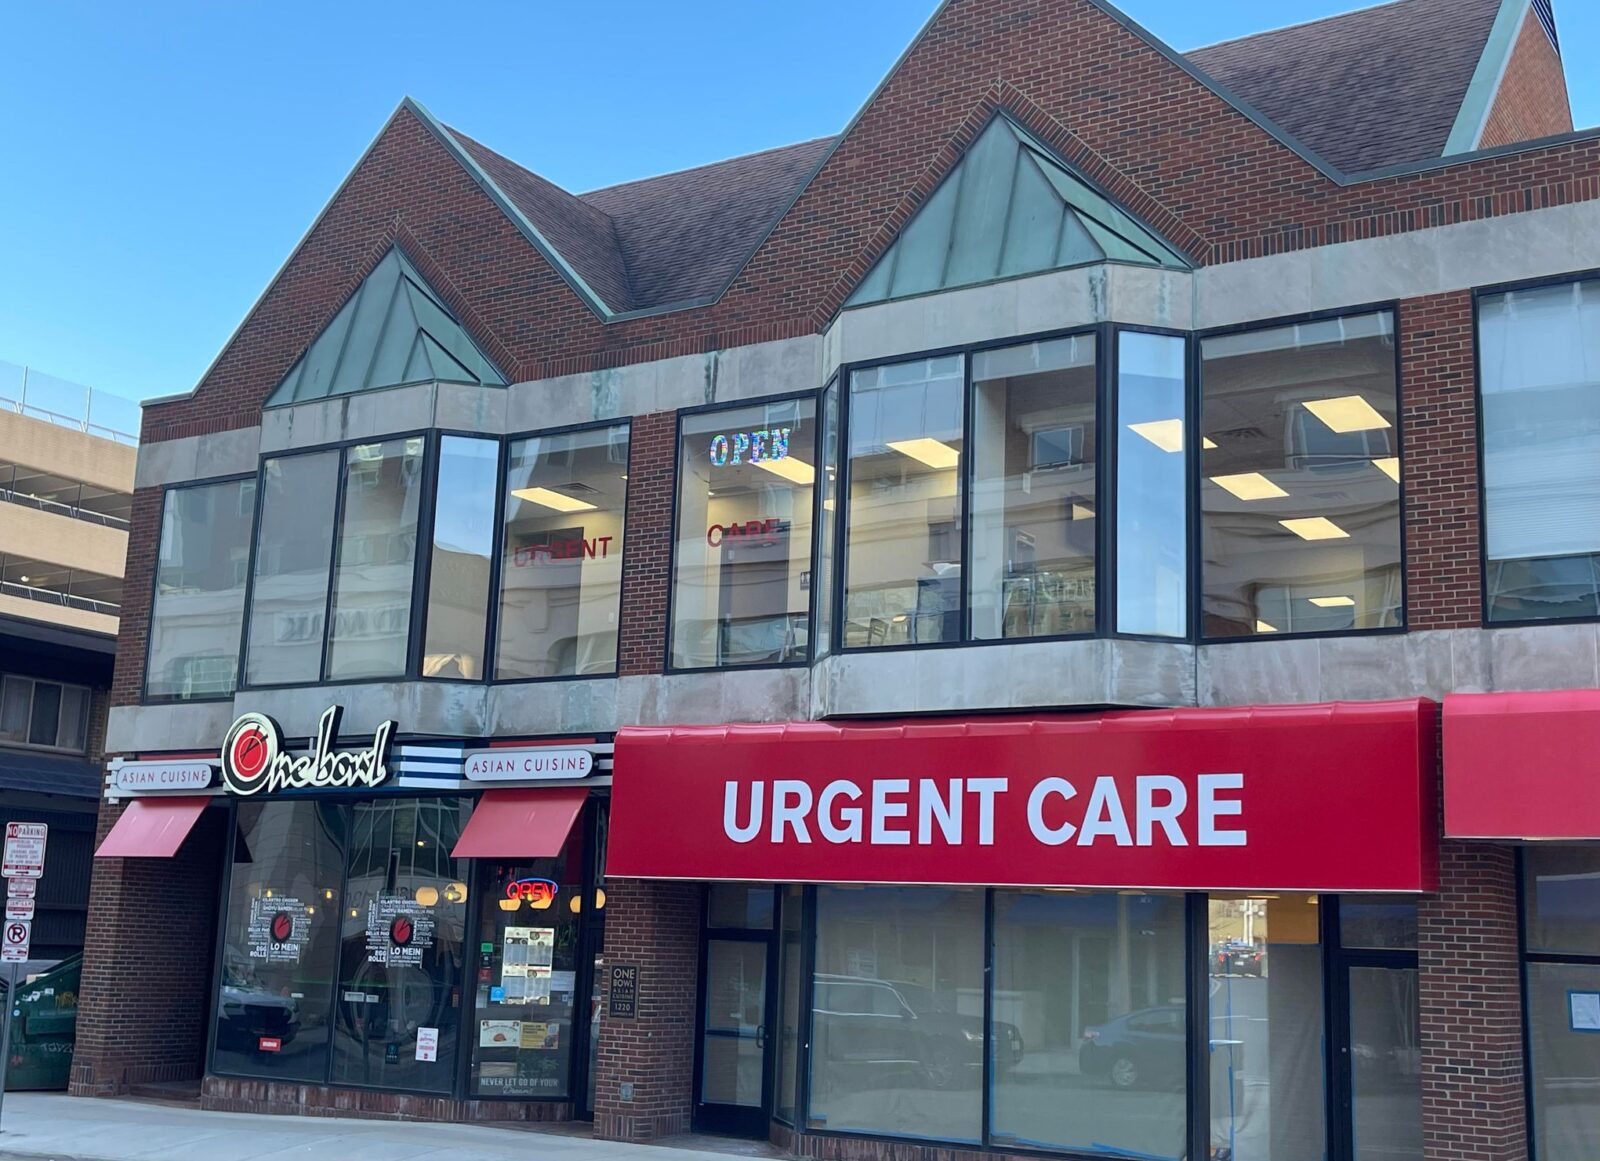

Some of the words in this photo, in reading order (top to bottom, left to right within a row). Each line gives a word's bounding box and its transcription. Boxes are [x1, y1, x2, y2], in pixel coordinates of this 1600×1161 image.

[710, 428, 790, 466] OPEN
[707, 519, 780, 547] CARE
[472, 760, 515, 773] ASIAN
[524, 757, 586, 772] CUISINE
[122, 772, 155, 783] ASIAN
[161, 770, 208, 782] CUISINE
[722, 777, 1008, 845] URGENT
[1026, 773, 1247, 847] CARE
[8, 825, 18, 837] NO
[18, 825, 45, 837] PARKING
[506, 882, 555, 901] OPEN
[281, 943, 298, 951] MEIN
[390, 947, 400, 955] LO
[402, 947, 421, 956] MEIN
[368, 955, 386, 963] ROLLS
[613, 968, 635, 979] ONE
[612, 979, 634, 988] BOWL
[614, 1003, 631, 1011] 1220
[480, 1077, 503, 1086] NEVER
[504, 1078, 517, 1086] LET
[519, 1078, 528, 1086] GO
[529, 1078, 537, 1087] OF
[540, 1078, 558, 1087] YOUR
